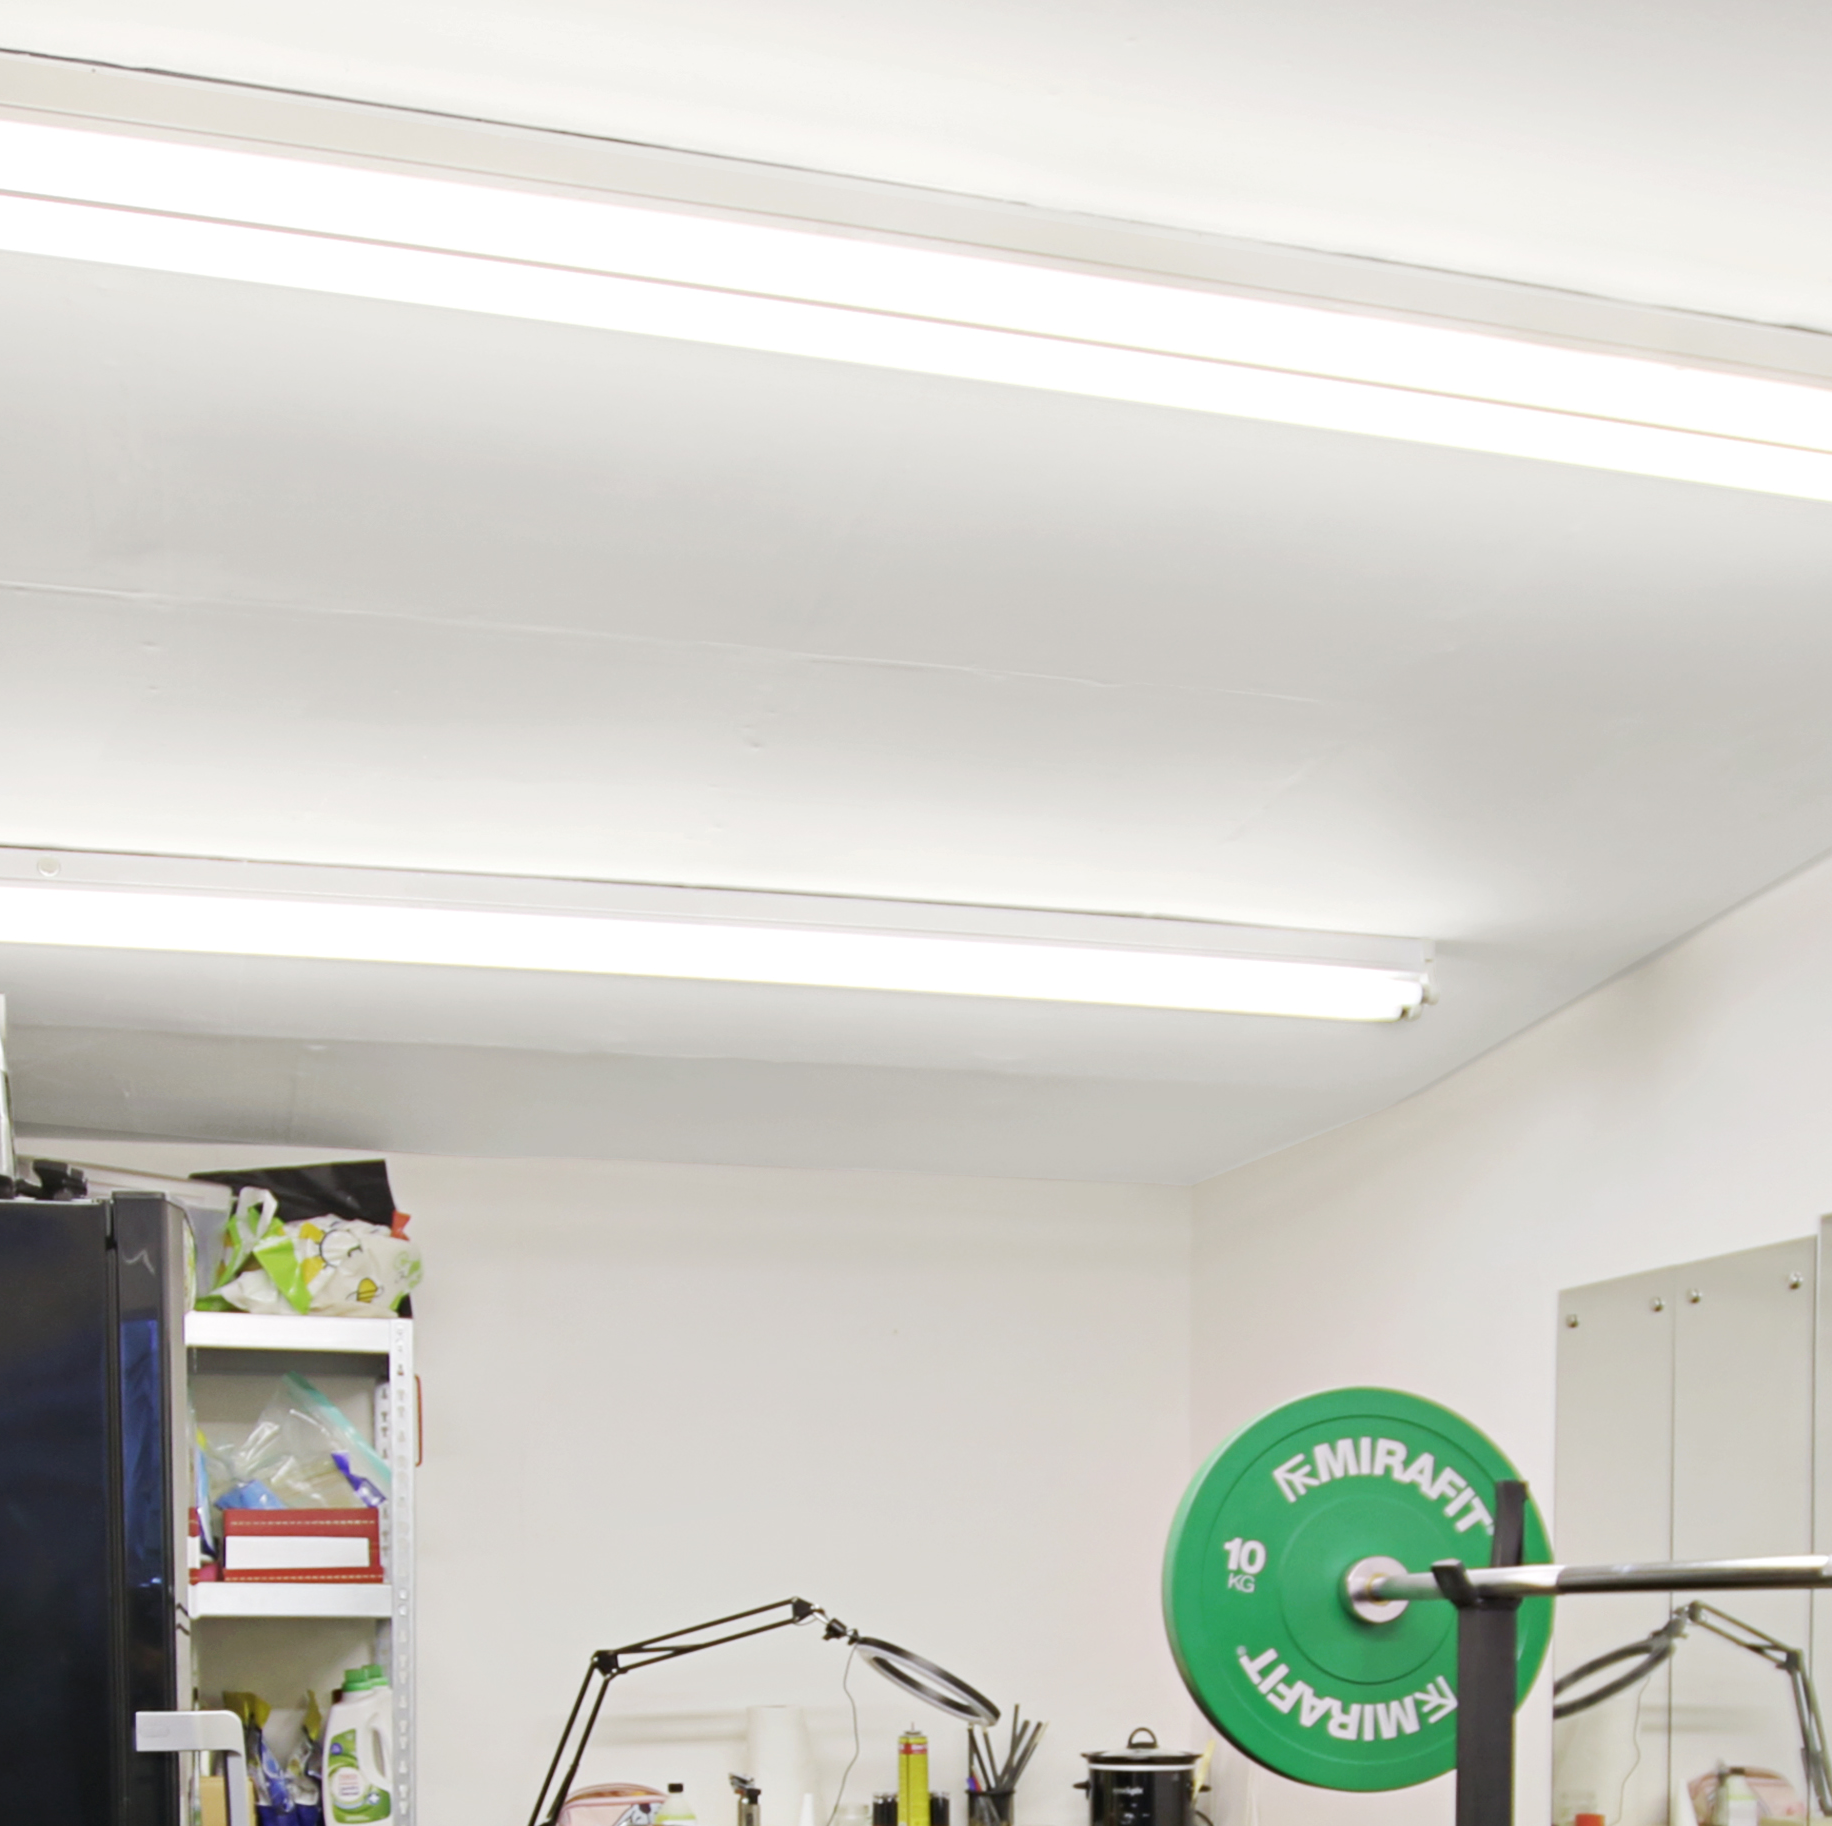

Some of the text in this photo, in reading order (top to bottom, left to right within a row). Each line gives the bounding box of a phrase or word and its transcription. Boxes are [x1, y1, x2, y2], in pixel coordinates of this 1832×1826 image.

[1313, 1436, 1495, 1535] MIRAFIT
[1223, 1537, 1266, 1576] 10
[1227, 1572, 1255, 1593] KG
[1239, 1647, 1421, 1741] MIRAFIT
